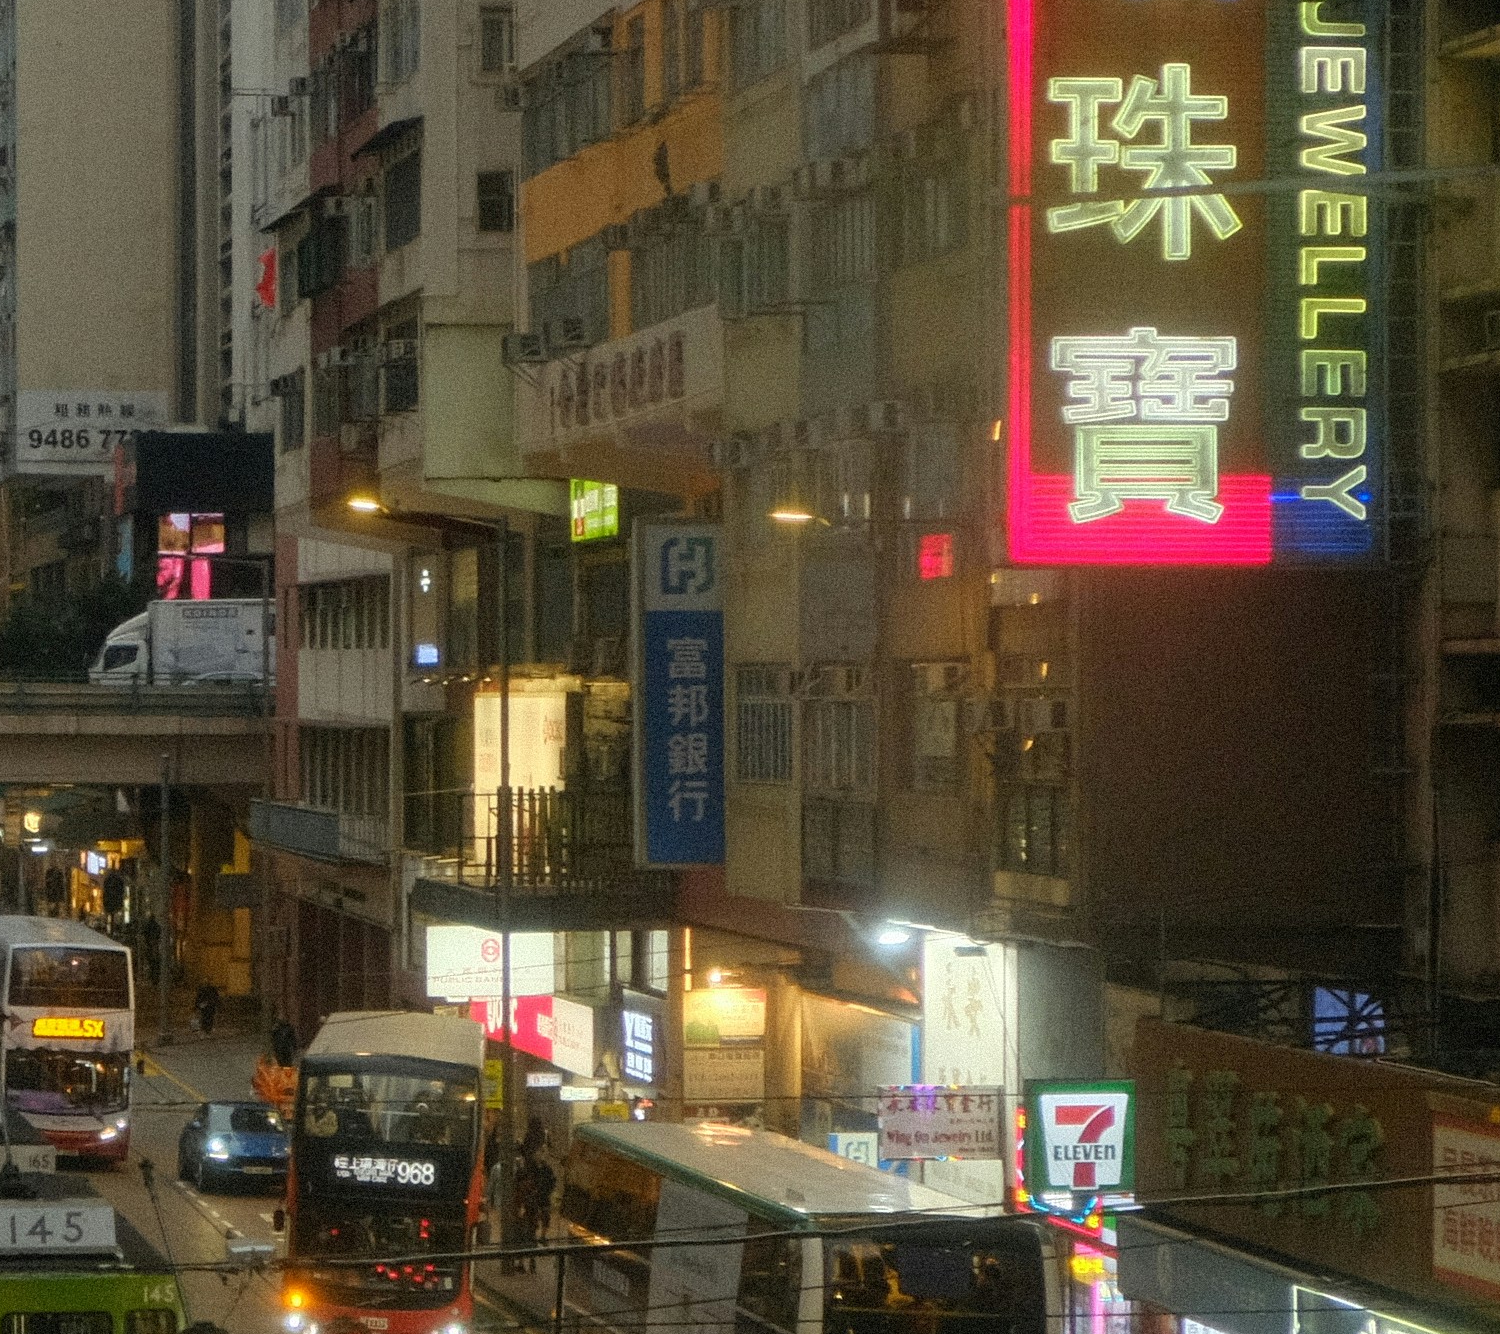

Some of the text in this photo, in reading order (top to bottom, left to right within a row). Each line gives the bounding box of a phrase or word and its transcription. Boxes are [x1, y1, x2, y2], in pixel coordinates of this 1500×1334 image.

[28, 431, 91, 450] 9486
[666, 636, 709, 823] 富邦銀行
[475, 974, 504, 984] BAN
[1054, 1105, 1116, 1190] 7
[397, 1161, 435, 1185] 968
[10, 1211, 84, 1246] 145
[142, 1283, 175, 1304] 145
